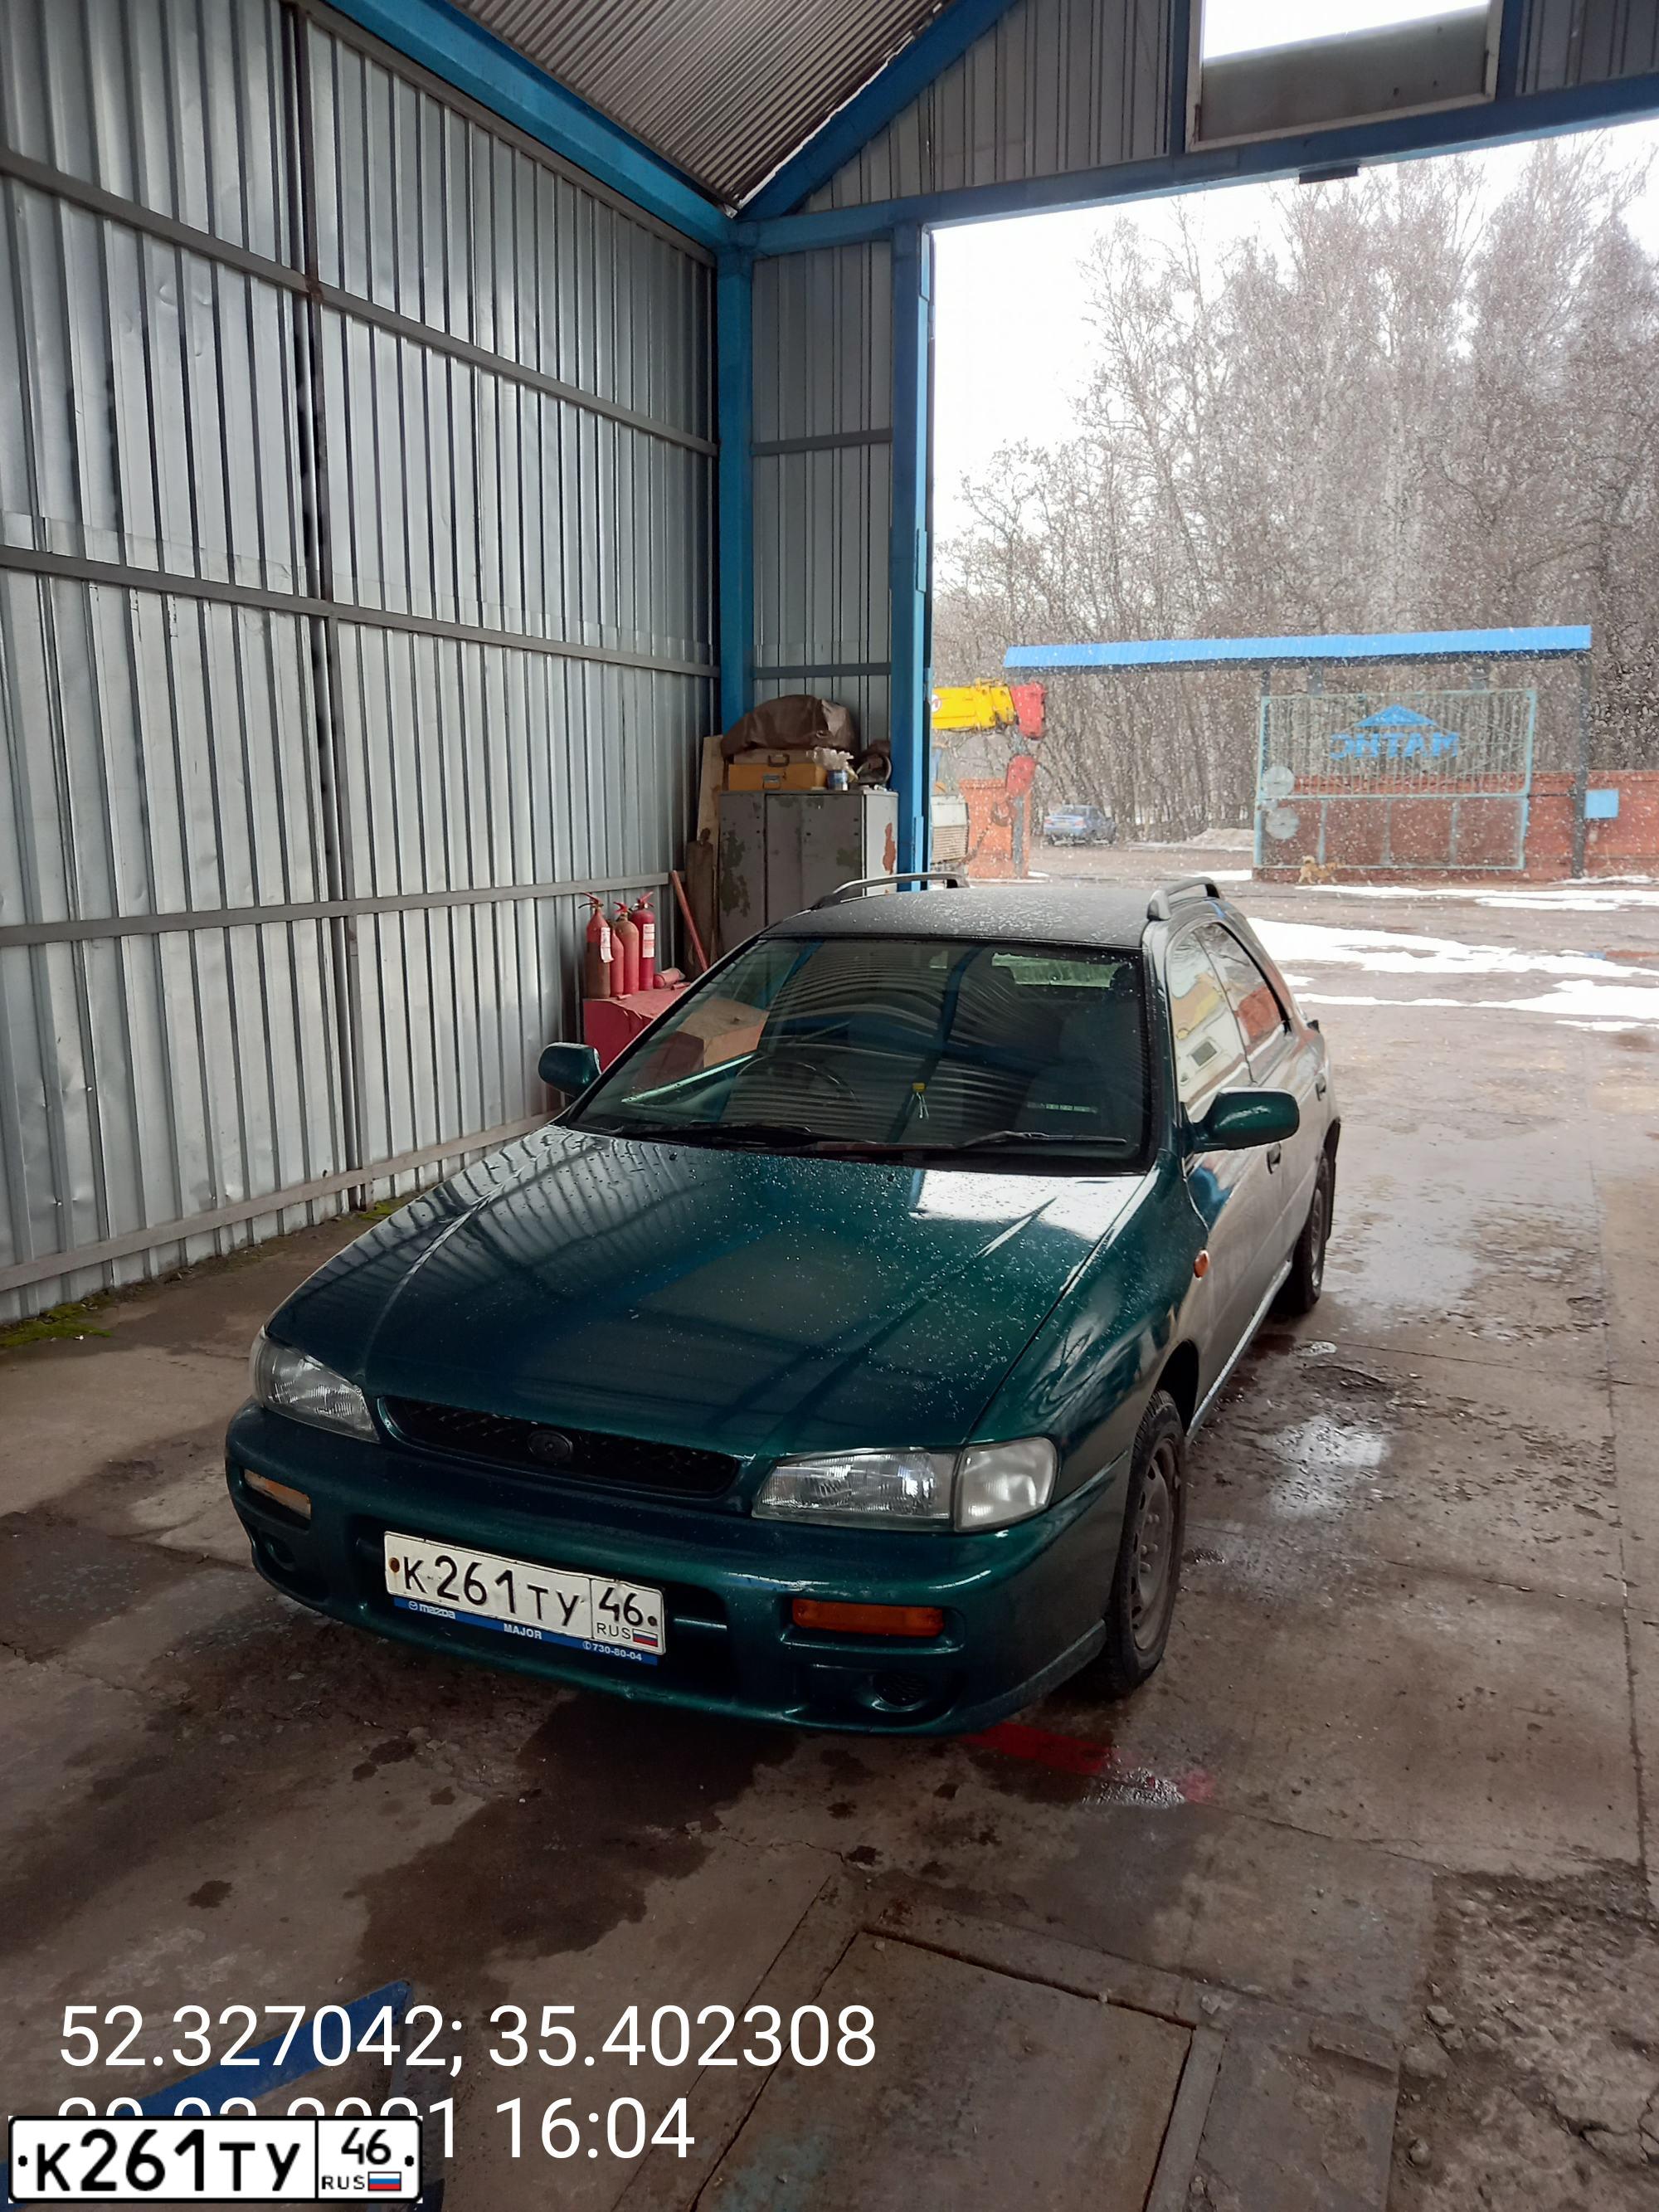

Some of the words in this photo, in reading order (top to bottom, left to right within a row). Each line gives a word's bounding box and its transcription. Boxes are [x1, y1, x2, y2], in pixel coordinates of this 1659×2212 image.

[598, 1586, 643, 1626] 46
[503, 1622, 542, 1640] MAJOR
[592, 1643, 643, 1661] 730-80-04
[596, 1622, 631, 1640] RUS
